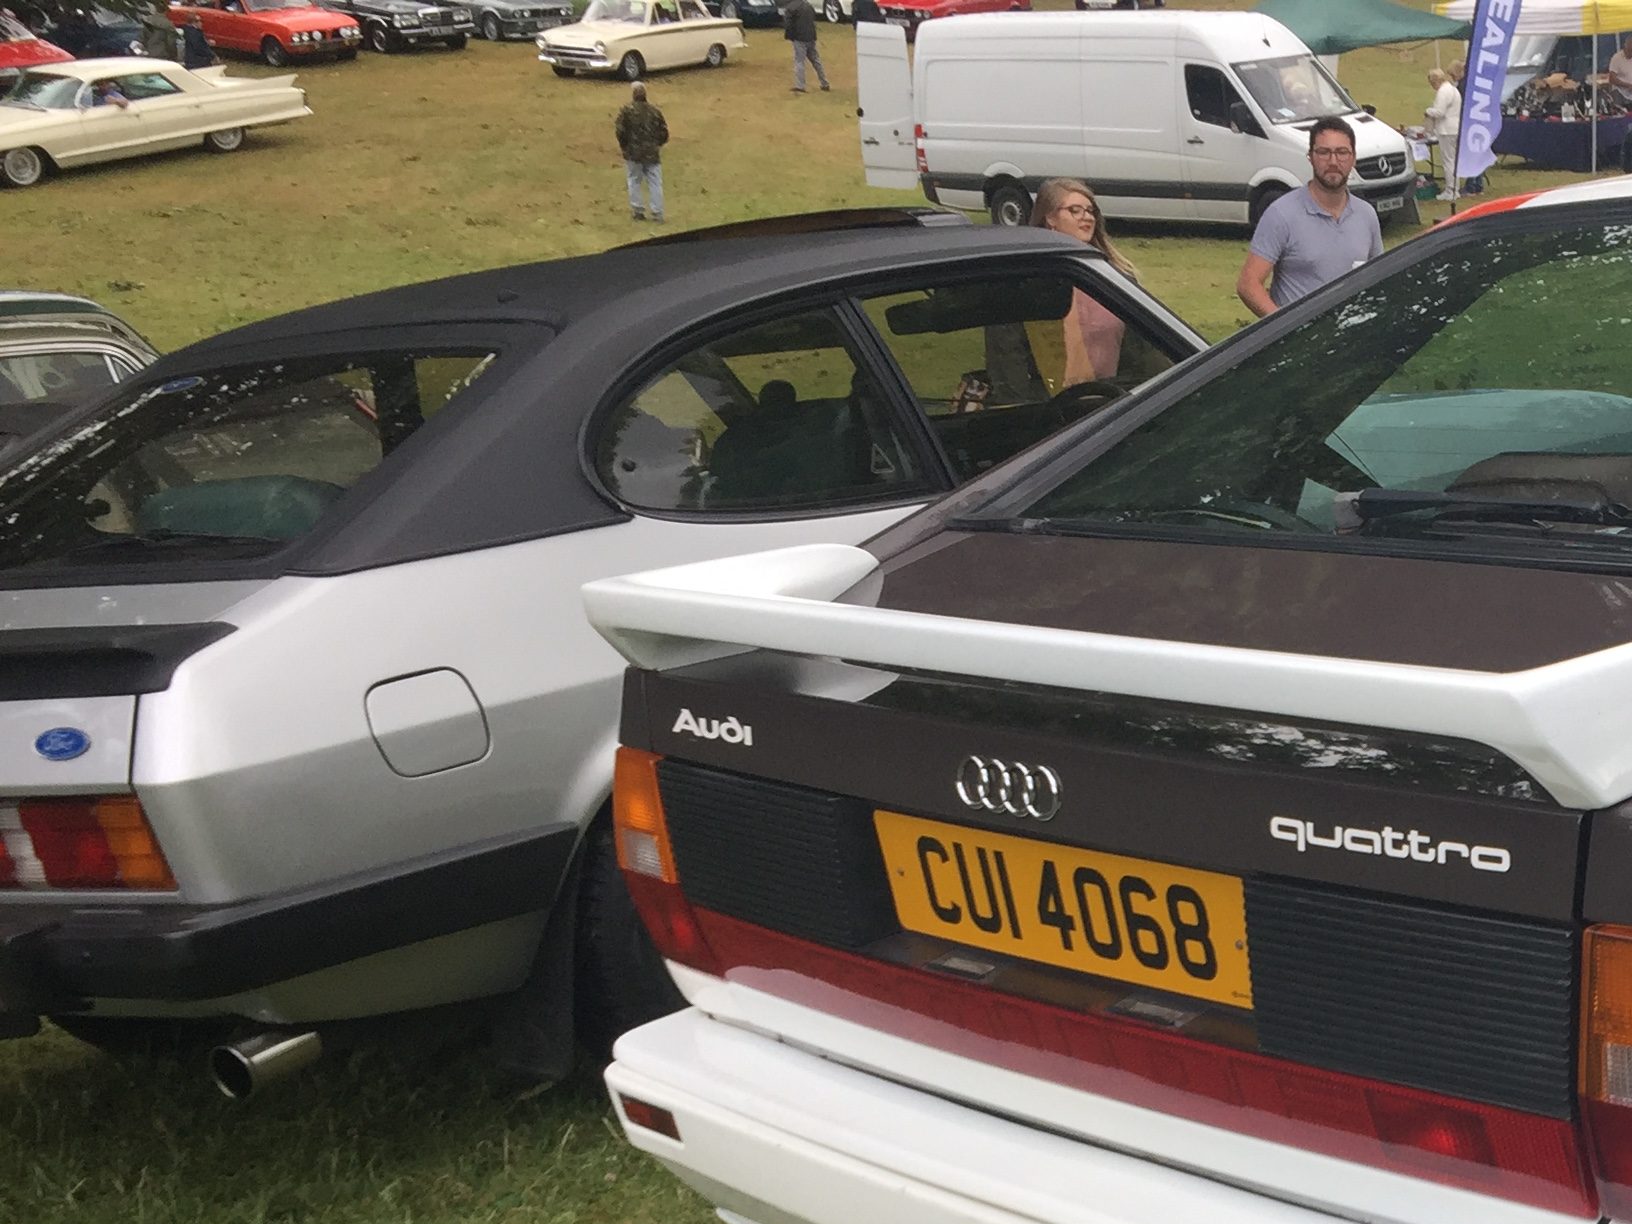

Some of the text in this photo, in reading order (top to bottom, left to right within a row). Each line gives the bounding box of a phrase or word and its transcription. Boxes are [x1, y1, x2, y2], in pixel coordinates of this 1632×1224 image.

[672, 707, 753, 746] Audi
[1270, 816, 1511, 872] quattro
[917, 835, 1217, 980] CUI 4068
